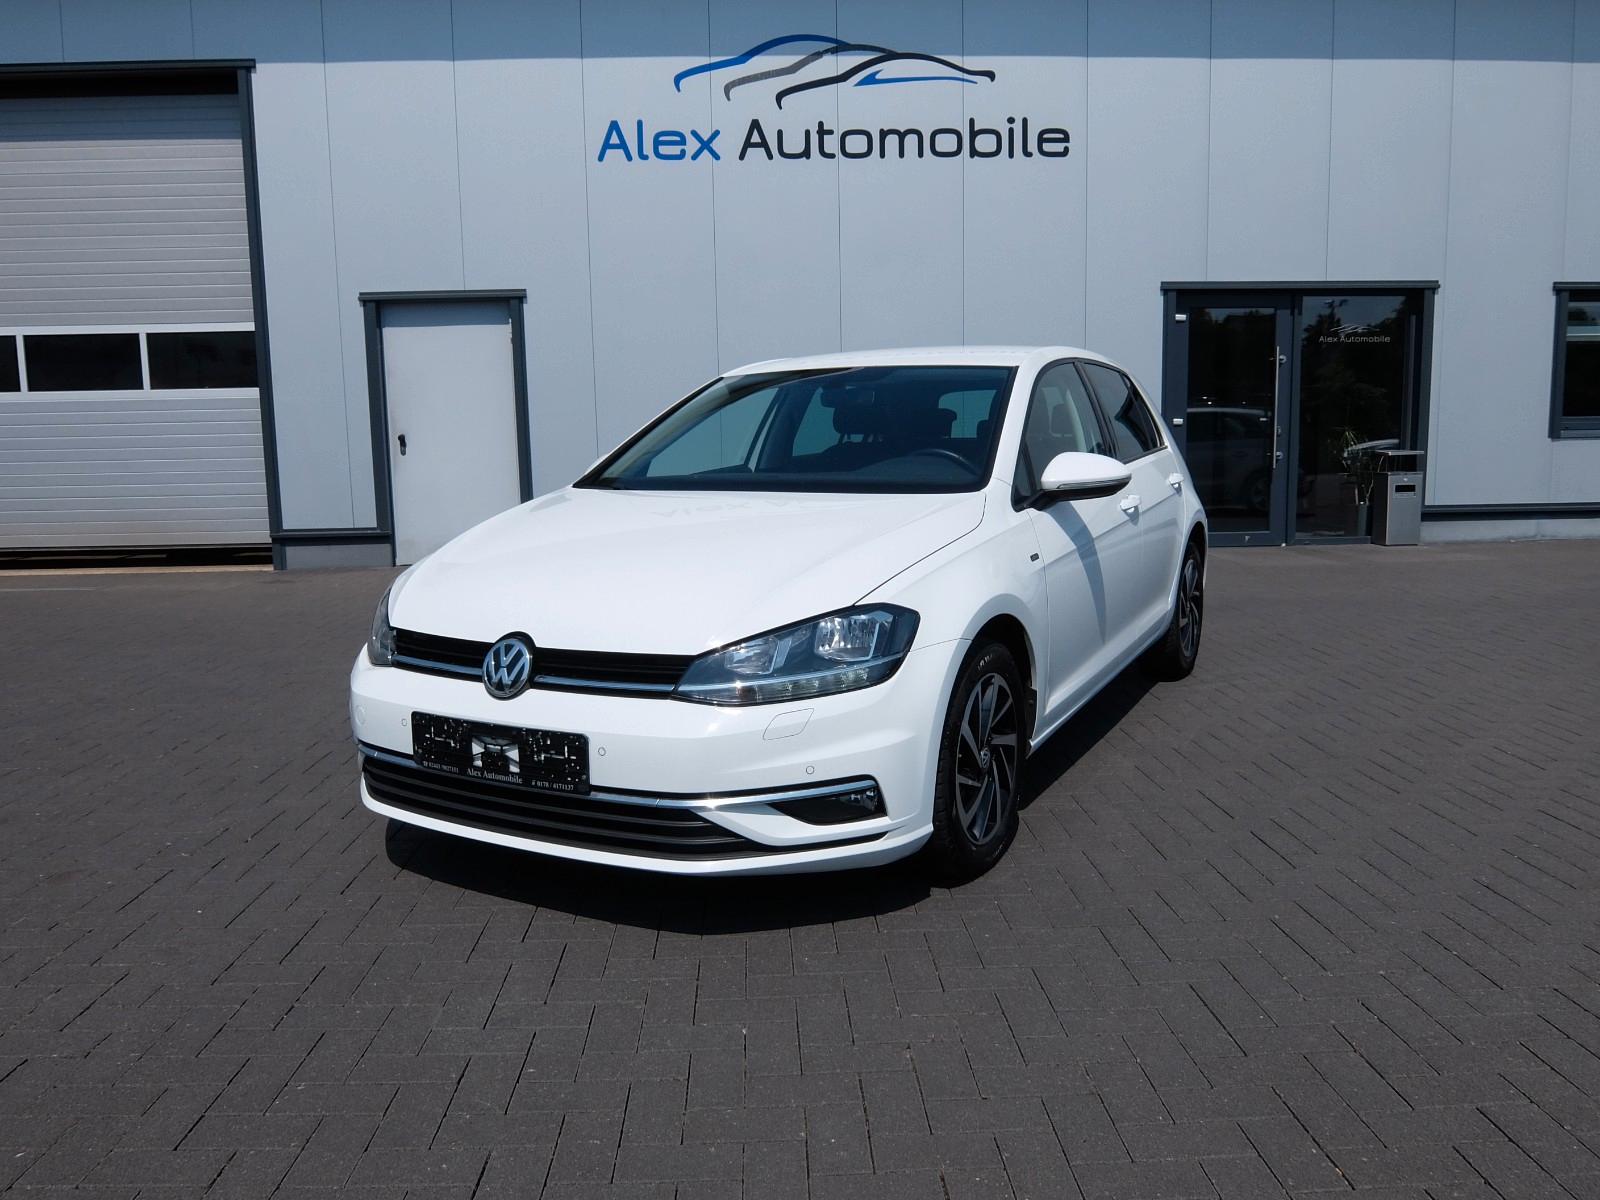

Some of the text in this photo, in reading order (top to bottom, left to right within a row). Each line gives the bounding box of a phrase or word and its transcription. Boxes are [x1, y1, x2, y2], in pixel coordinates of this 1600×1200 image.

[597, 116, 1070, 162] Alex Automobile
[1318, 335, 1391, 343] Alex Automobile
[467, 768, 523, 784] Alex Automobile
